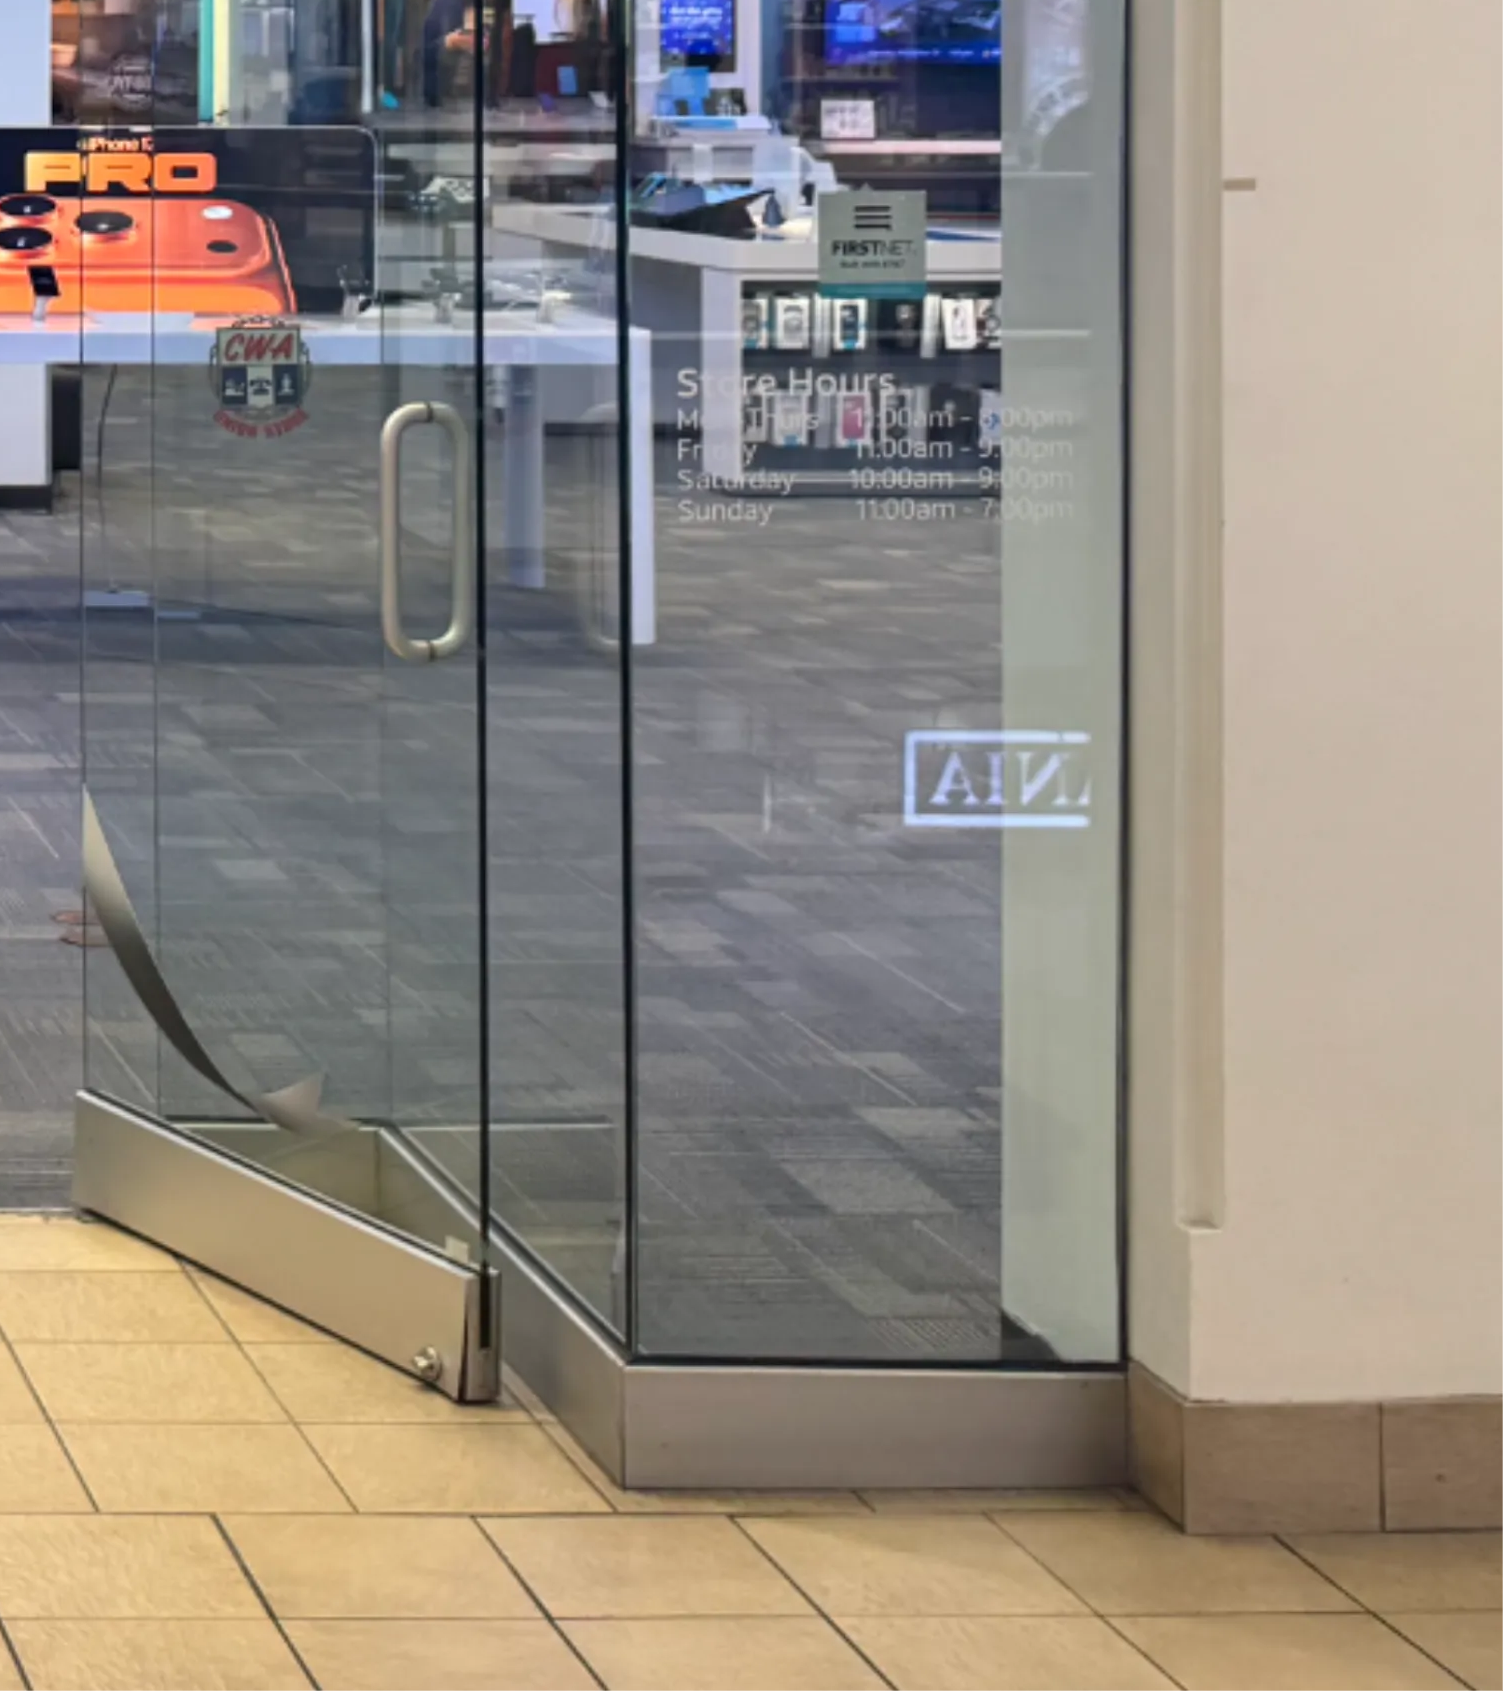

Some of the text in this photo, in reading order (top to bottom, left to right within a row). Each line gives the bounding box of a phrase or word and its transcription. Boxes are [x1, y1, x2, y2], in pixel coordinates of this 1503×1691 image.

[25, 151, 218, 193] PRO
[224, 332, 294, 361] CWA
[677, 366, 896, 399] Store Hours
[677, 498, 773, 526] Sunday
